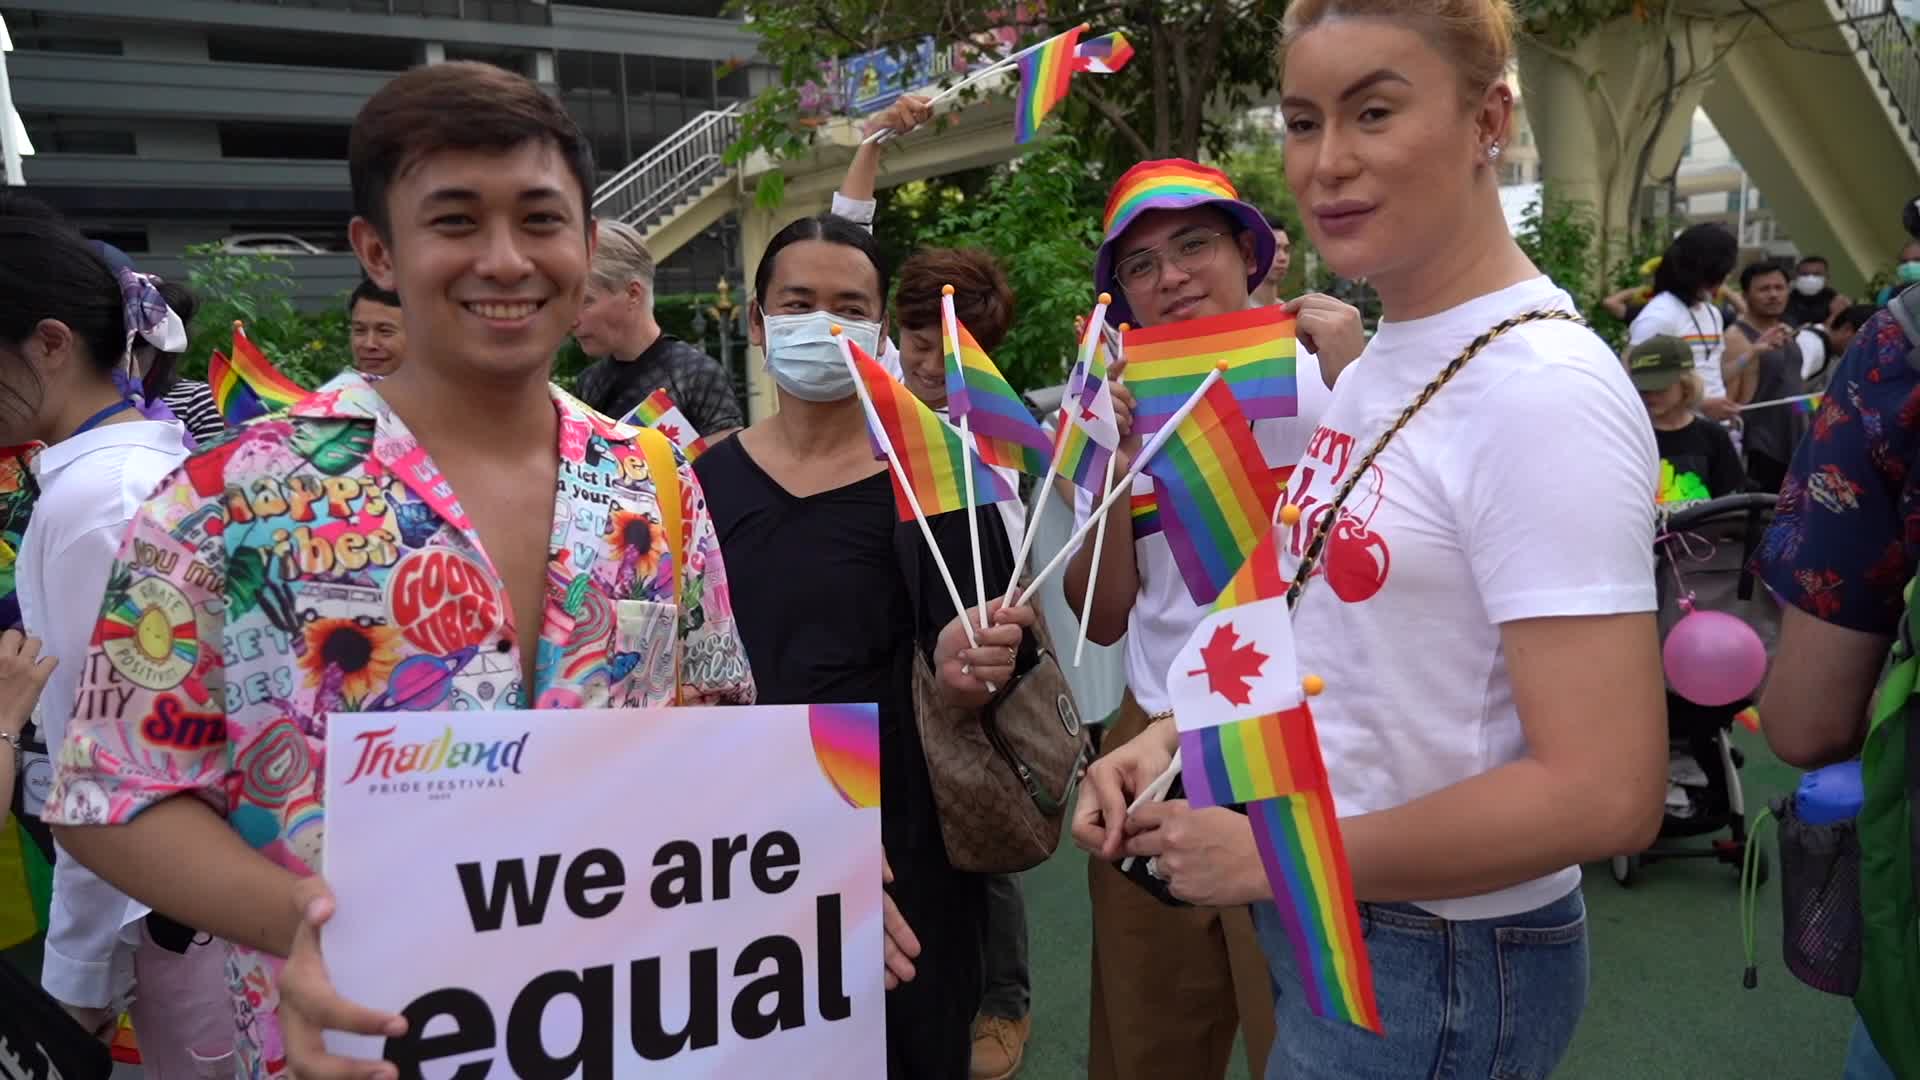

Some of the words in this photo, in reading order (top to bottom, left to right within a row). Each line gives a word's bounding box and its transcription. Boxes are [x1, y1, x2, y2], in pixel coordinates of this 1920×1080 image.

[258, 525, 400, 582] ibes
[391, 552, 496, 627] GOOD
[343, 725, 532, 785] Thailand
[368, 782, 421, 795] PRIDE
[426, 777, 505, 792] FESTIVAL
[456, 847, 625, 933] we
[650, 830, 801, 910] are
[383, 893, 851, 1080] equal
